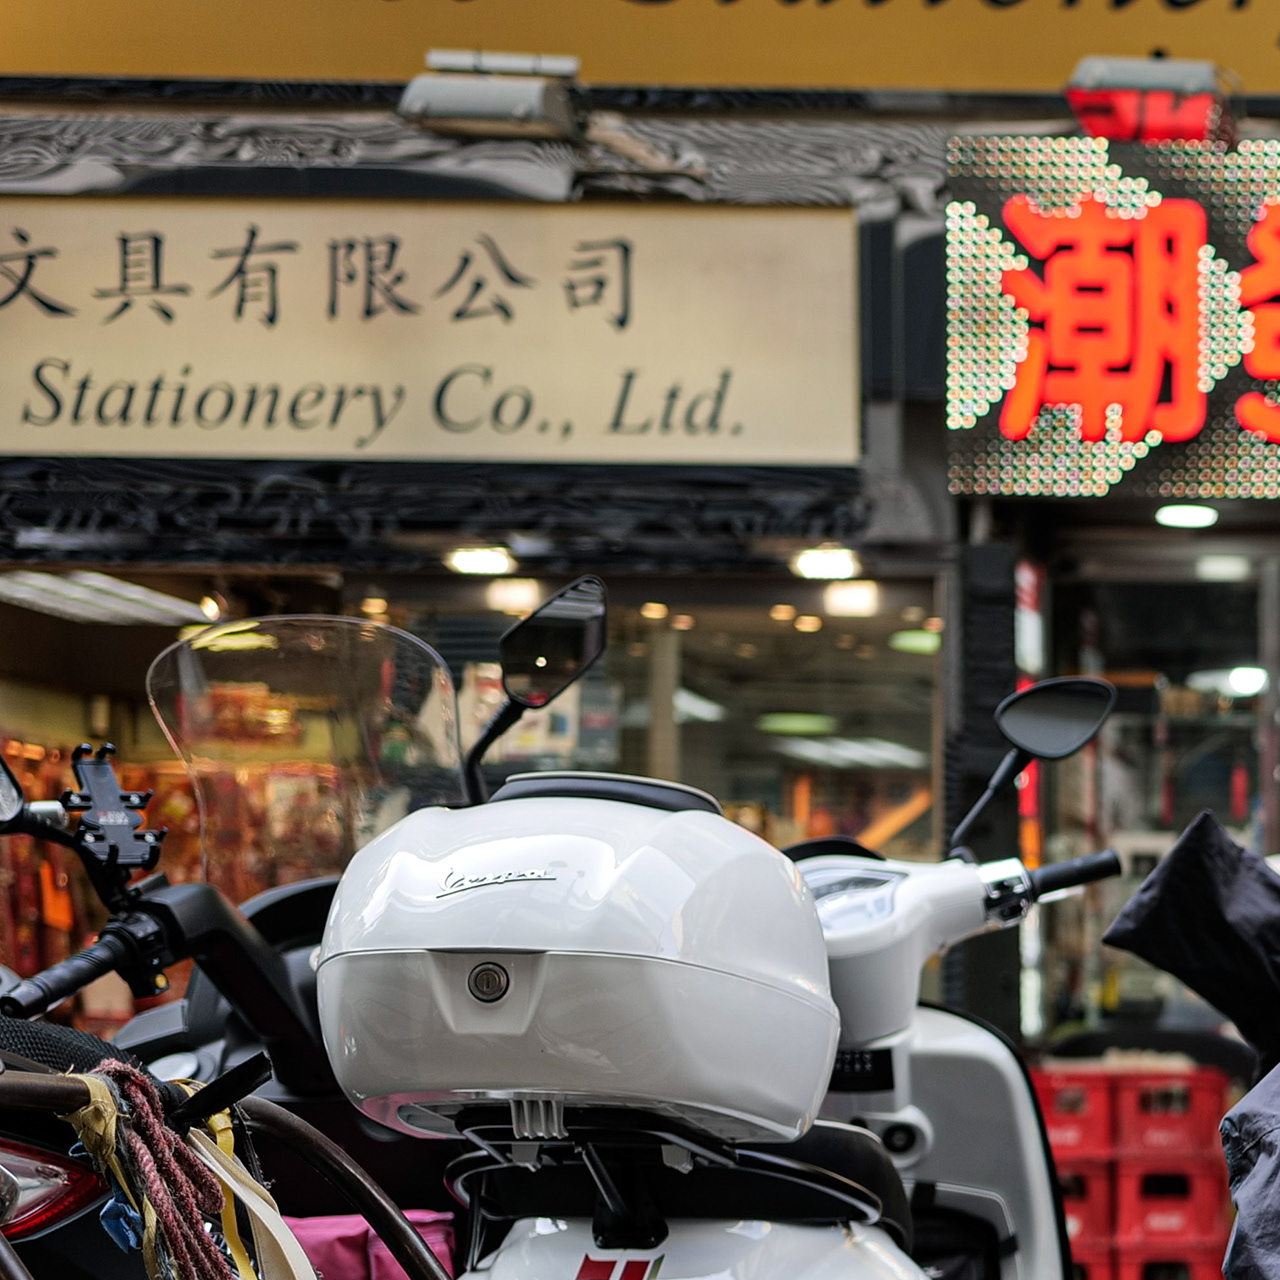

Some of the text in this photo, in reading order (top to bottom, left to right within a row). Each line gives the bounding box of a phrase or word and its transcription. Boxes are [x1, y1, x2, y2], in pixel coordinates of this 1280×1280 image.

[0, 226, 635, 329] 文具有限公司
[22, 357, 745, 448] Stationery Co., Ltd.
